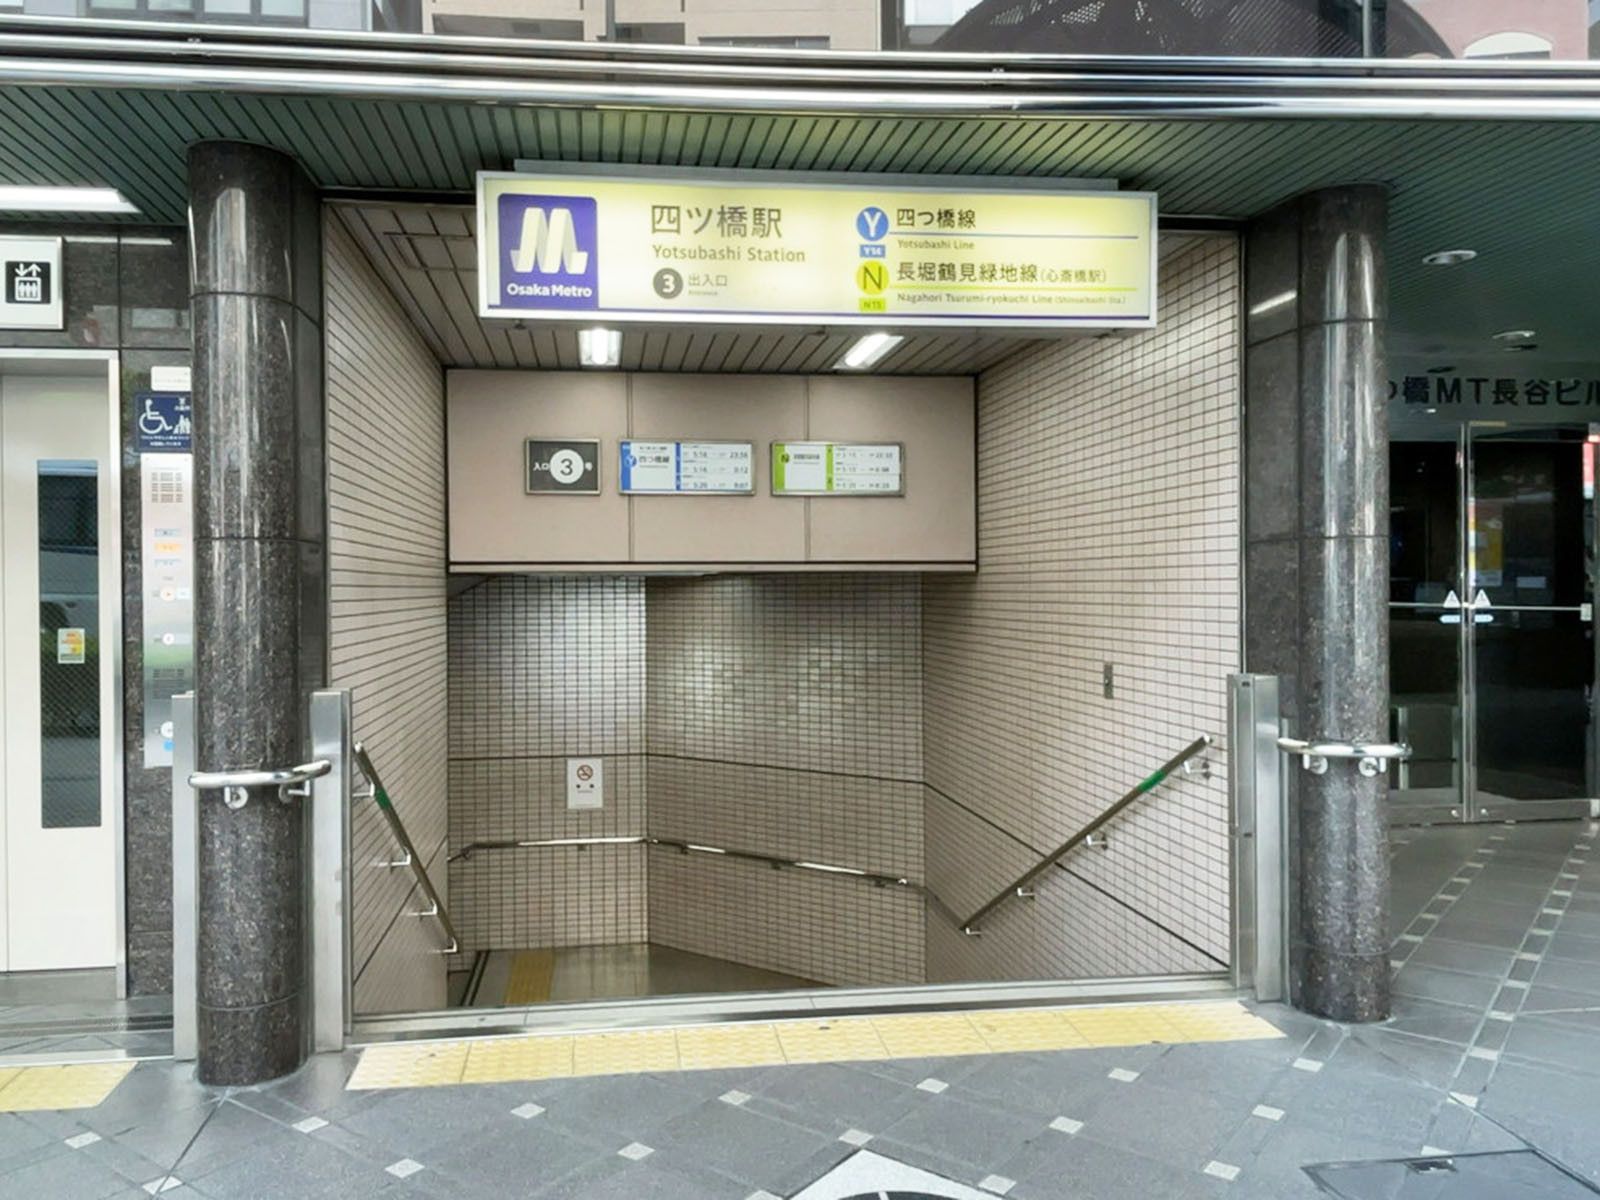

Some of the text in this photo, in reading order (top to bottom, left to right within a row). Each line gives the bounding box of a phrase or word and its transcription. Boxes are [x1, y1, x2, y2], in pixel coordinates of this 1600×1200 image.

[651, 204, 783, 239] 四ツ橋駅
[862, 210, 882, 239] Y
[896, 208, 976, 230] 四つ橋線
[652, 244, 806, 264] Yotsubashi Station
[898, 240, 975, 251] Yotsubashi Line
[688, 273, 728, 287] 出入口
[863, 265, 883, 291] N
[506, 282, 593, 298] Osaka Metro
[897, 293, 943, 305] Nagahori
[1032, 294, 1053, 304] Line
[532, 461, 550, 472] 入口
[559, 457, 574, 476] 3
